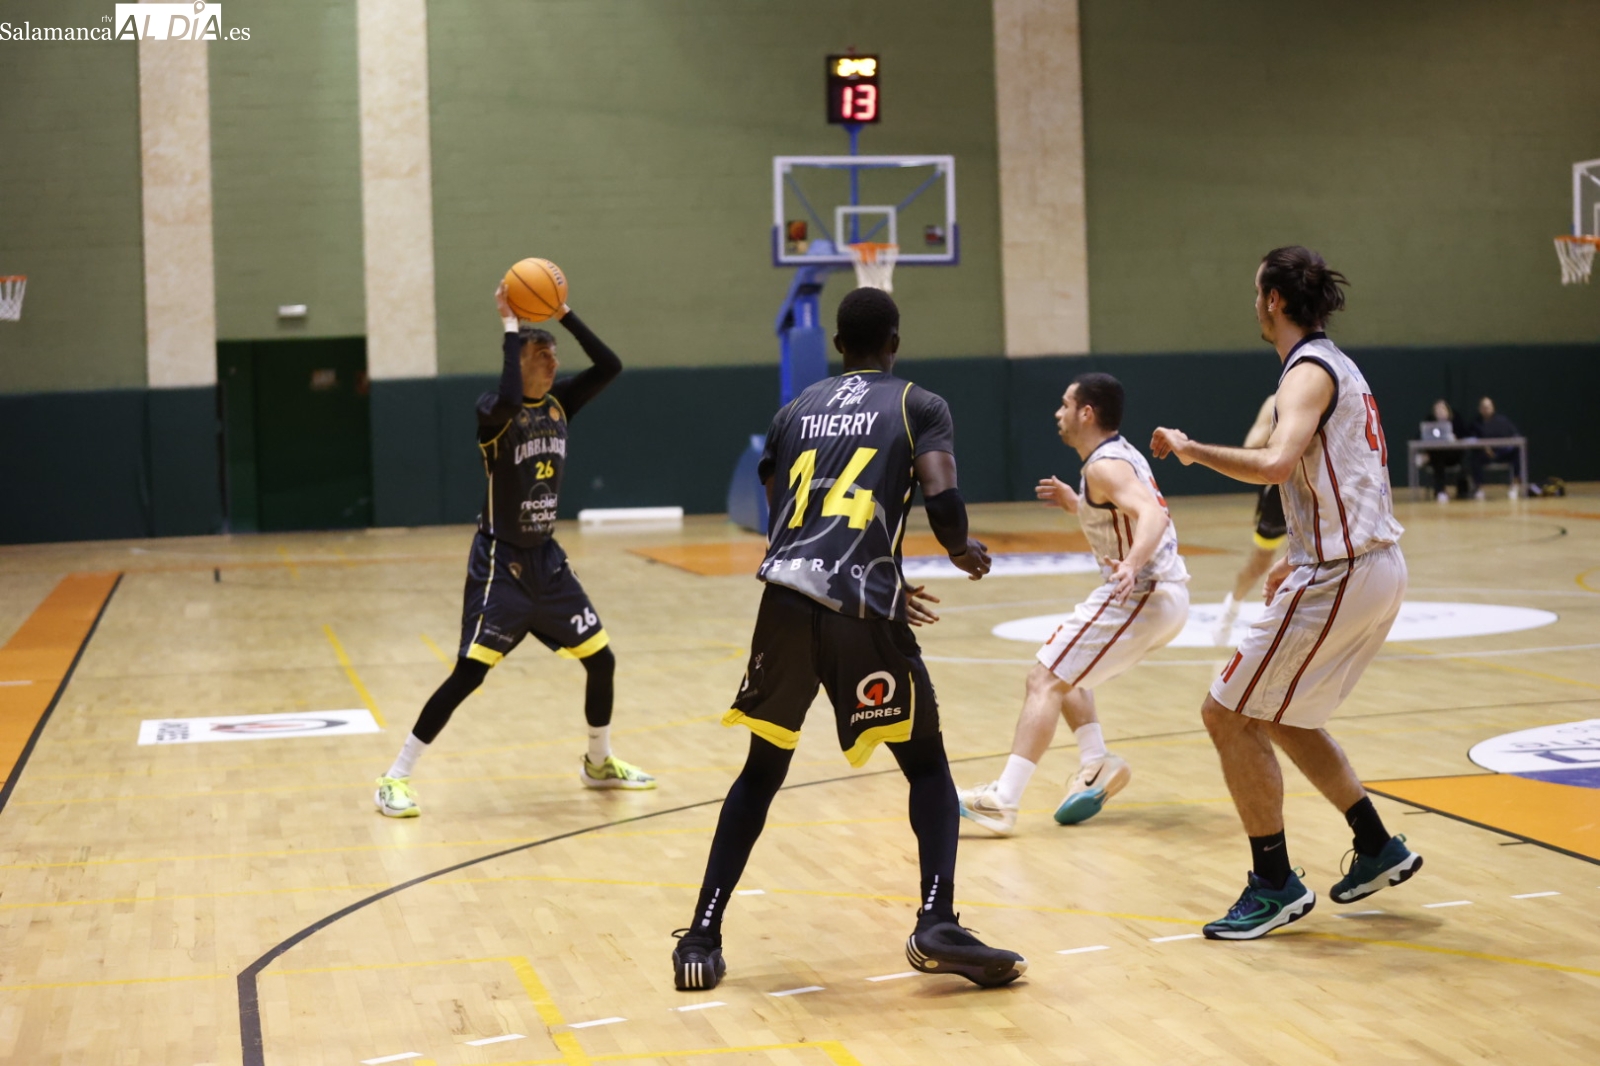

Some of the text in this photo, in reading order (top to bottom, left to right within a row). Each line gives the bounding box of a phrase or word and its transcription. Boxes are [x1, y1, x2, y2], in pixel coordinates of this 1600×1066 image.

[841, 85, 877, 121] 13
[801, 411, 879, 440] THIERRY
[535, 460, 555, 480] 26
[788, 447, 879, 530] 14
[570, 606, 598, 636] 26
